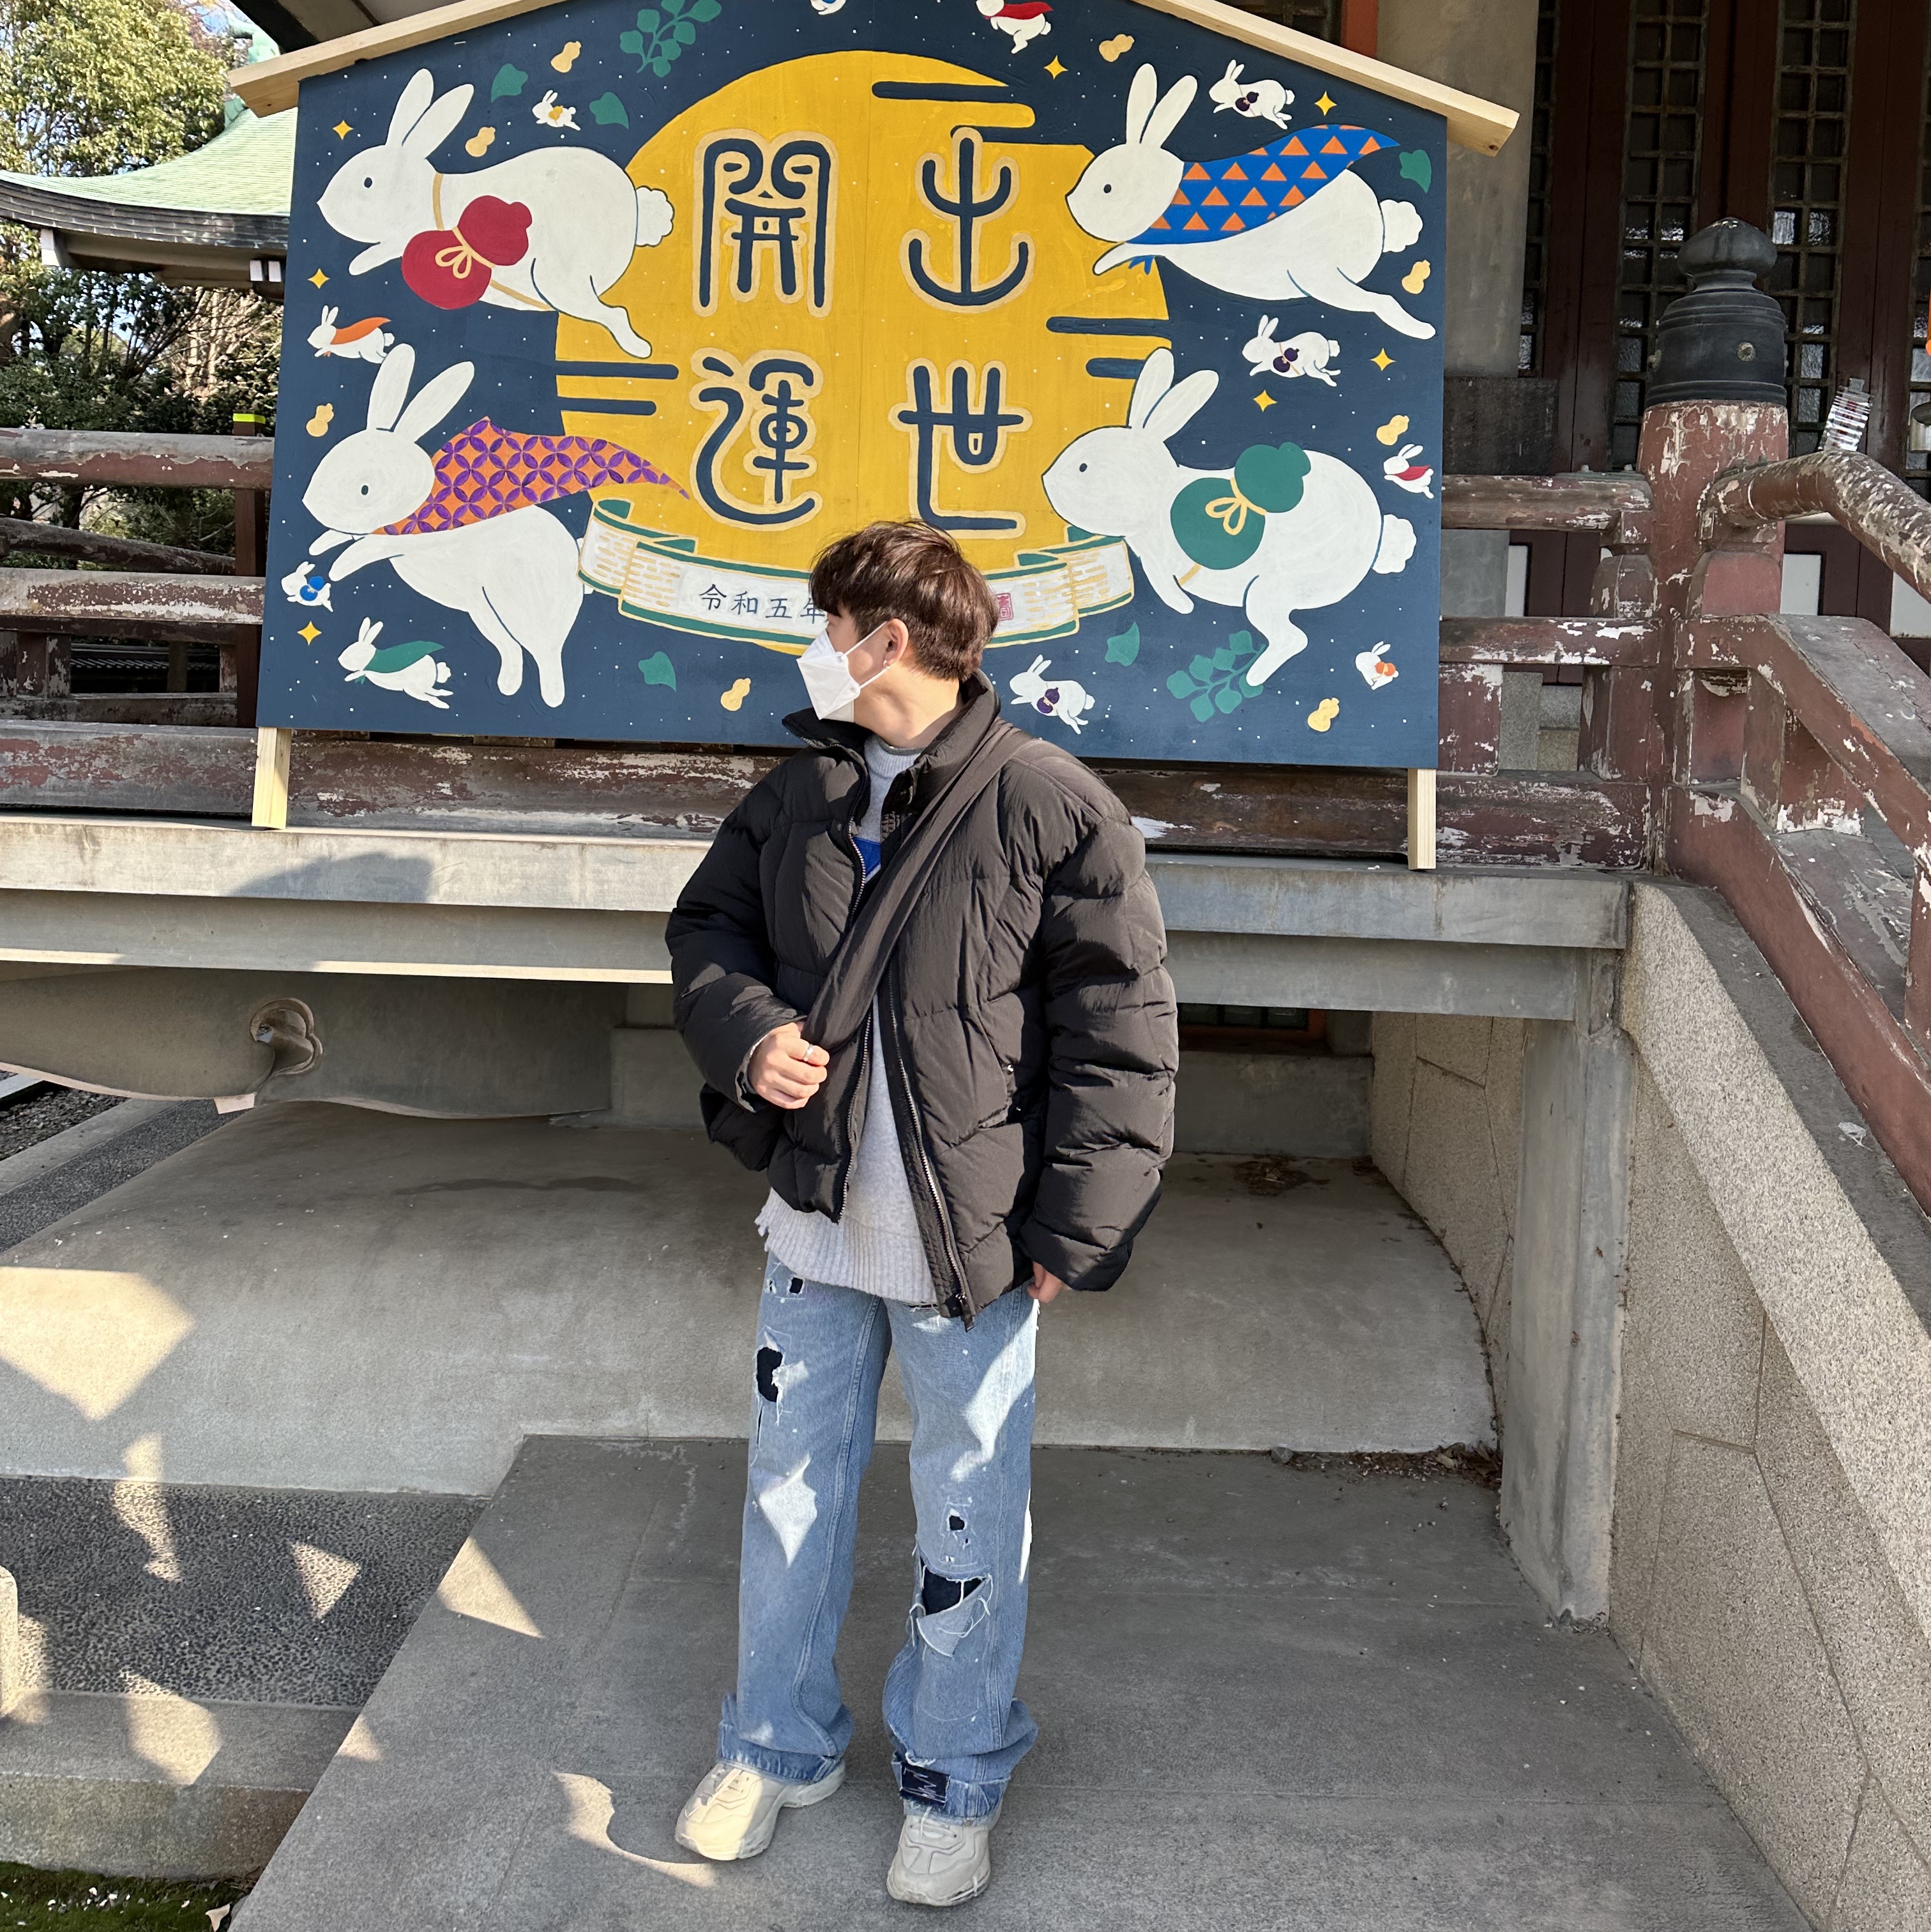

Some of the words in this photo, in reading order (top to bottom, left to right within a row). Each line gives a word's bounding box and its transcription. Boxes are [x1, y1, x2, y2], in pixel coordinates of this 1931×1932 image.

[696, 138, 831, 524] 開運
[897, 137, 1029, 530] 出世
[699, 583, 826, 625] 令和五年
